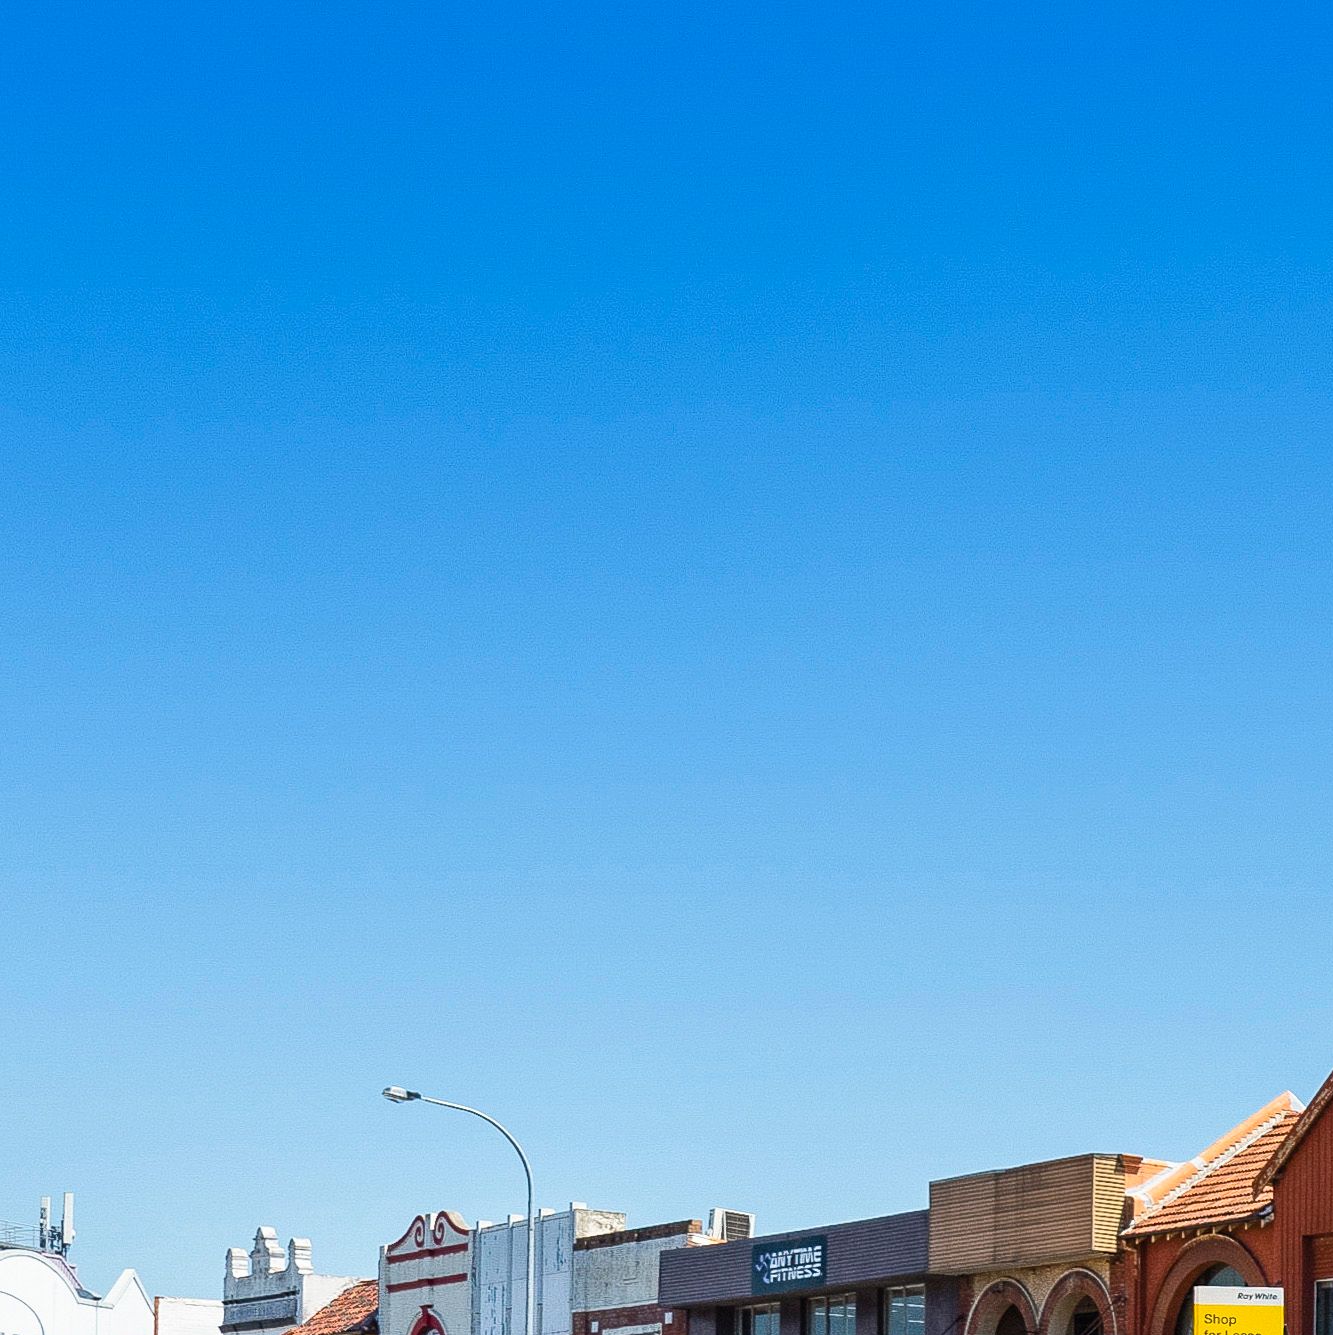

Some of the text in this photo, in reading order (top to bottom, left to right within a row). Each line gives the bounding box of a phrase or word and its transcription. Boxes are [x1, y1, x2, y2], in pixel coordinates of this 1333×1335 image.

[769, 1245, 822, 1269] ANYTIME
[769, 1263, 822, 1283] FITNESS
[1237, 1292, 1278, 1301] Ray White
[1204, 1313, 1237, 1326] Shop
